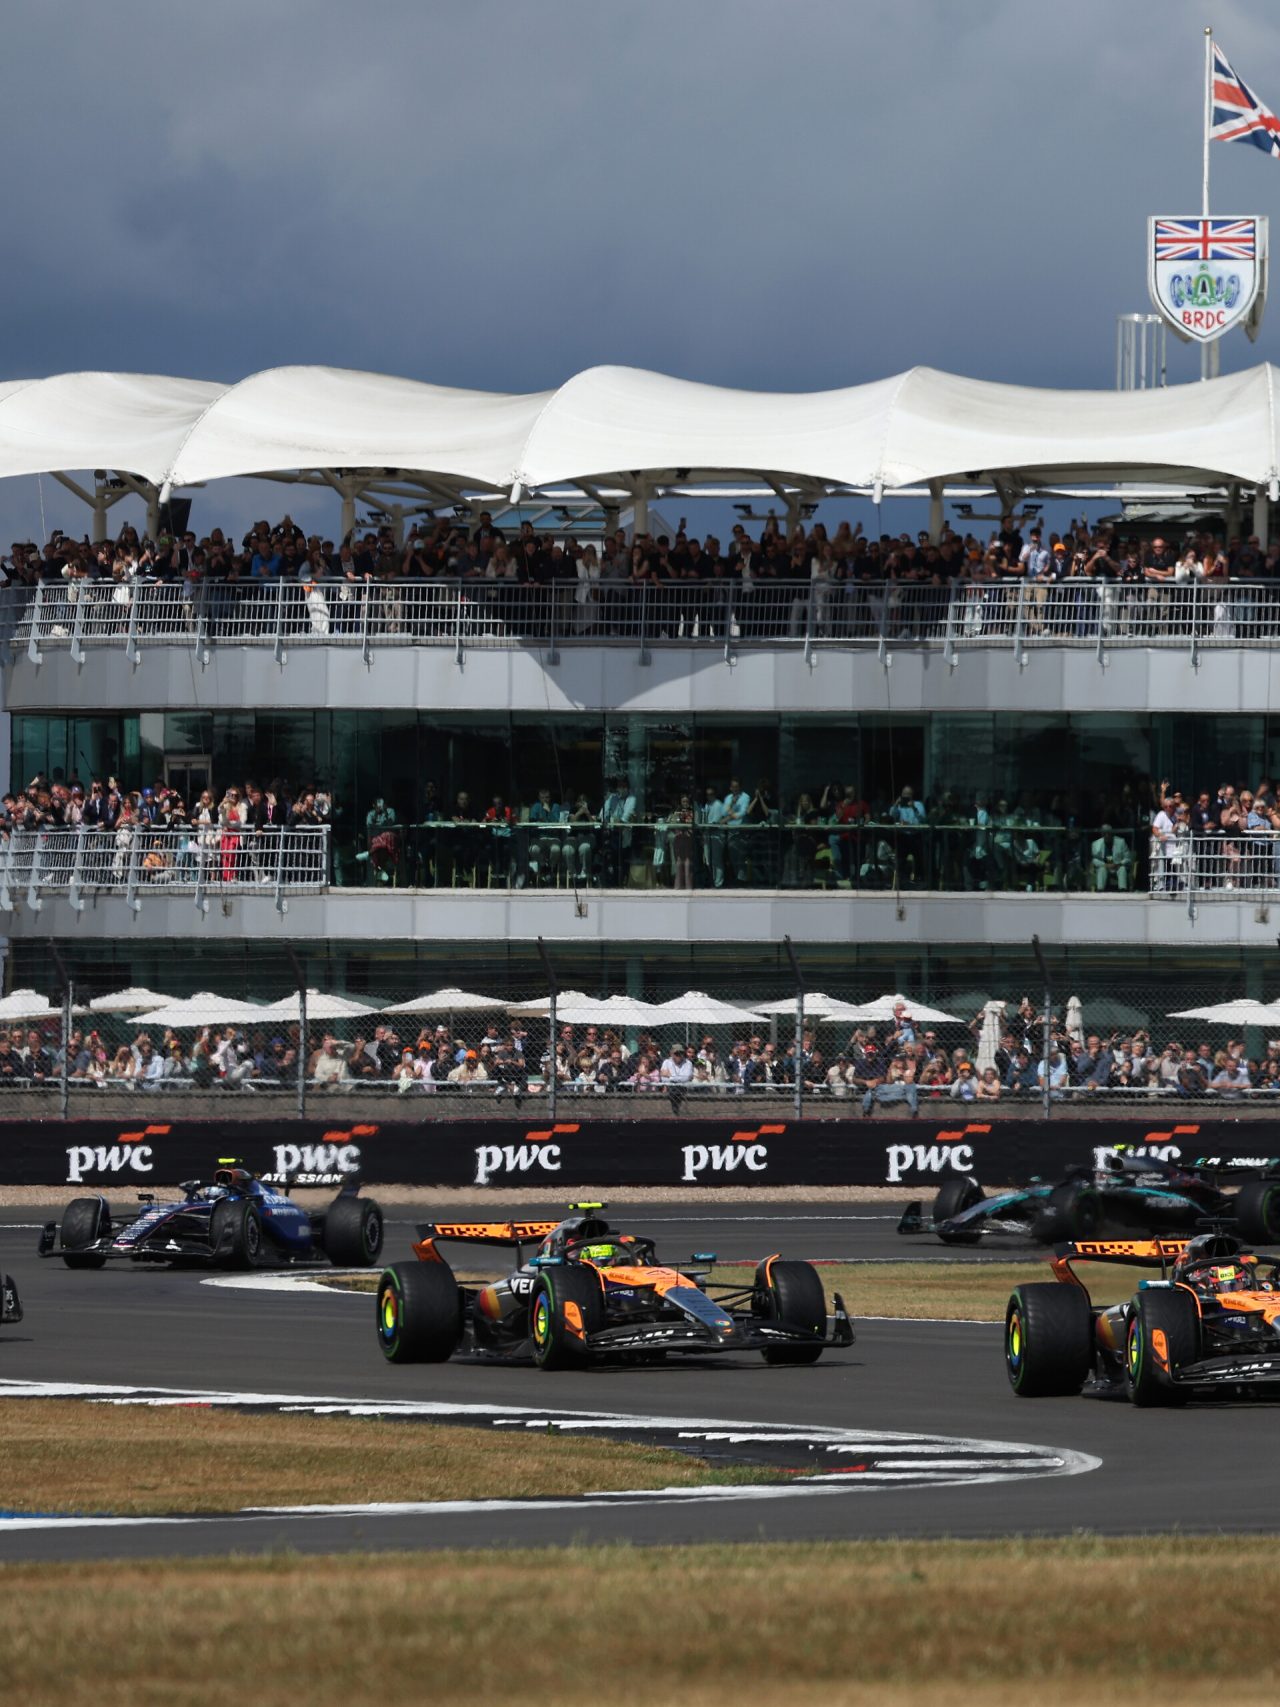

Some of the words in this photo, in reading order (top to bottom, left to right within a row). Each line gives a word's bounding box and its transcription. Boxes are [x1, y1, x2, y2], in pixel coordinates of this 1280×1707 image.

[1183, 310, 1224, 329] BRDC
[66, 1145, 153, 1182] pwc
[273, 1144, 360, 1174] pwc
[474, 1145, 561, 1184] pwc
[682, 1145, 768, 1182] pwc
[886, 1144, 974, 1182] pwc
[261, 1173, 343, 1184] ATLSSIAN
